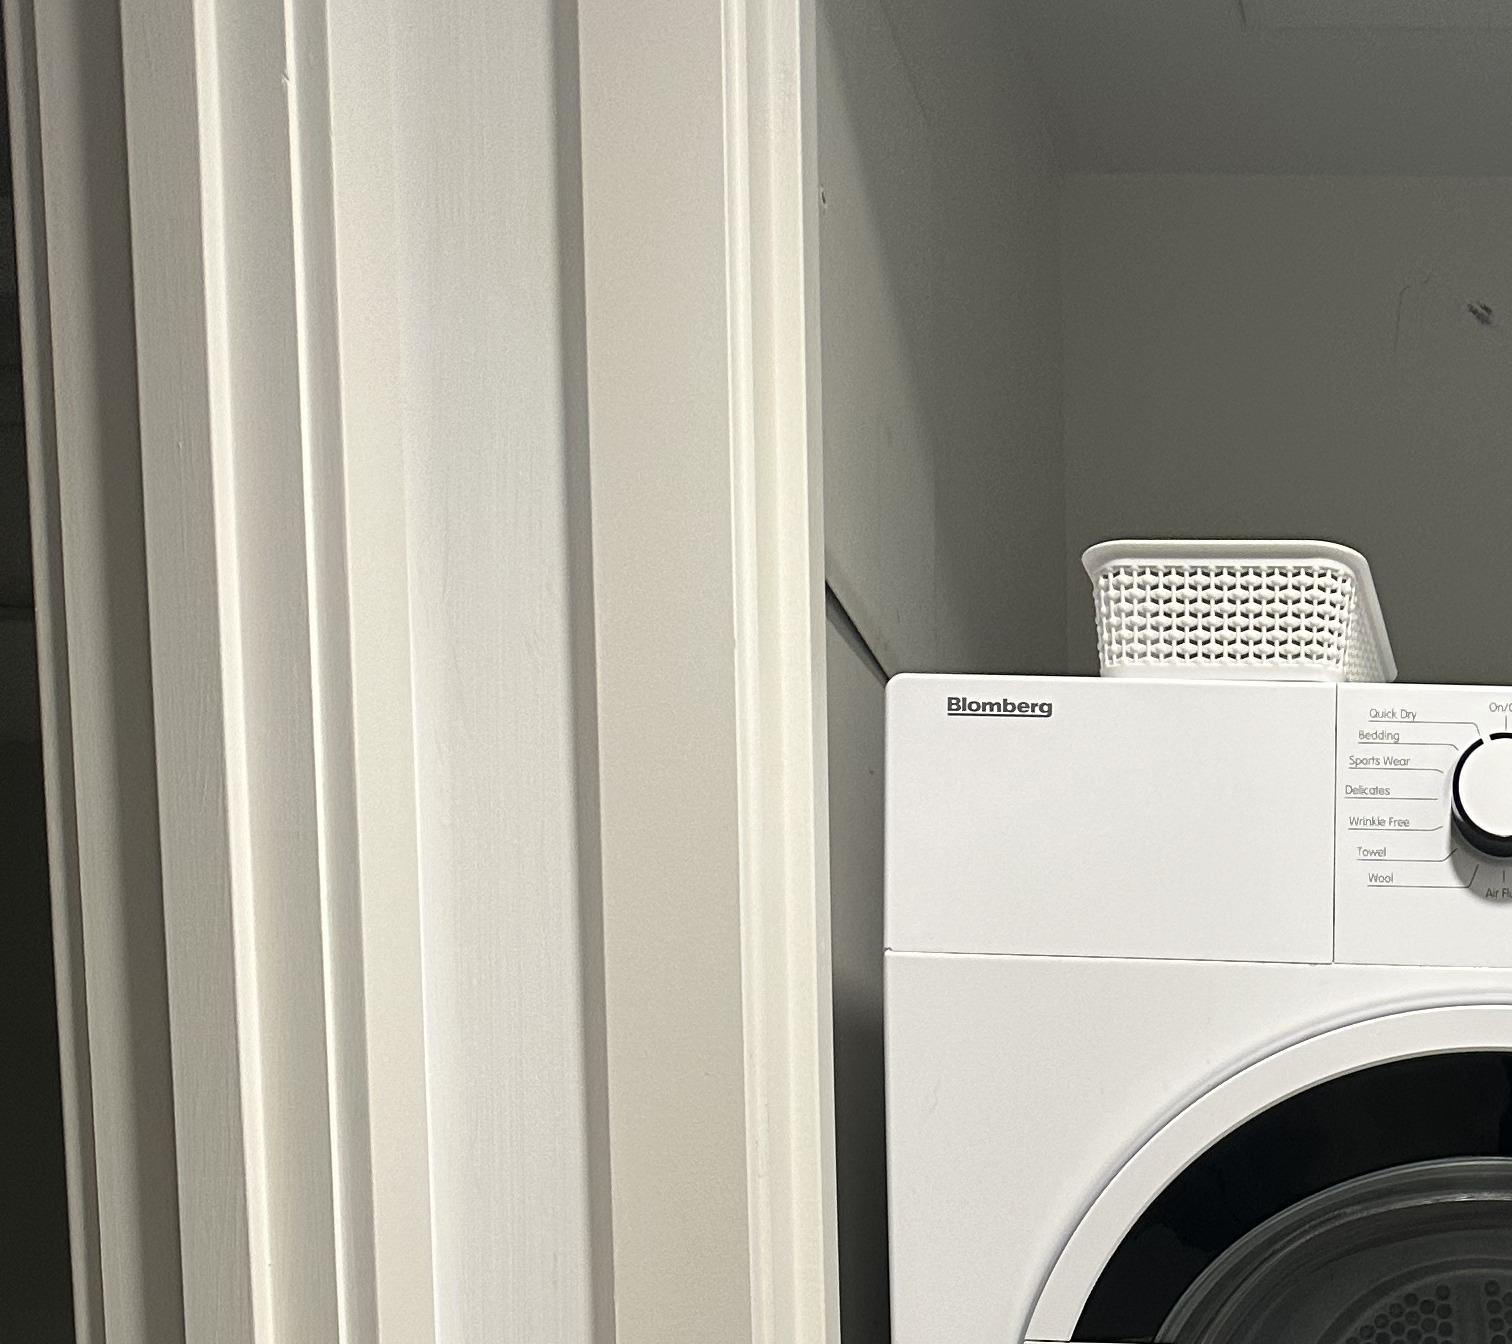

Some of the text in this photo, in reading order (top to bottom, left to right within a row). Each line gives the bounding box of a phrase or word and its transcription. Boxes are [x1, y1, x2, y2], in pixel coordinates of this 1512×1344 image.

[947, 697, 1053, 717] Blomberg
[1369, 707, 1417, 721] Quick Dry
[1358, 730, 1400, 742] Bedding
[1349, 755, 1411, 767] Sports Wear
[1345, 784, 1391, 796] Delicates
[1348, 816, 1410, 827] Wrinkle Free
[1356, 846, 1387, 857] Towel
[1368, 872, 1394, 883] Wool
[1485, 888, 1498, 899] Air
